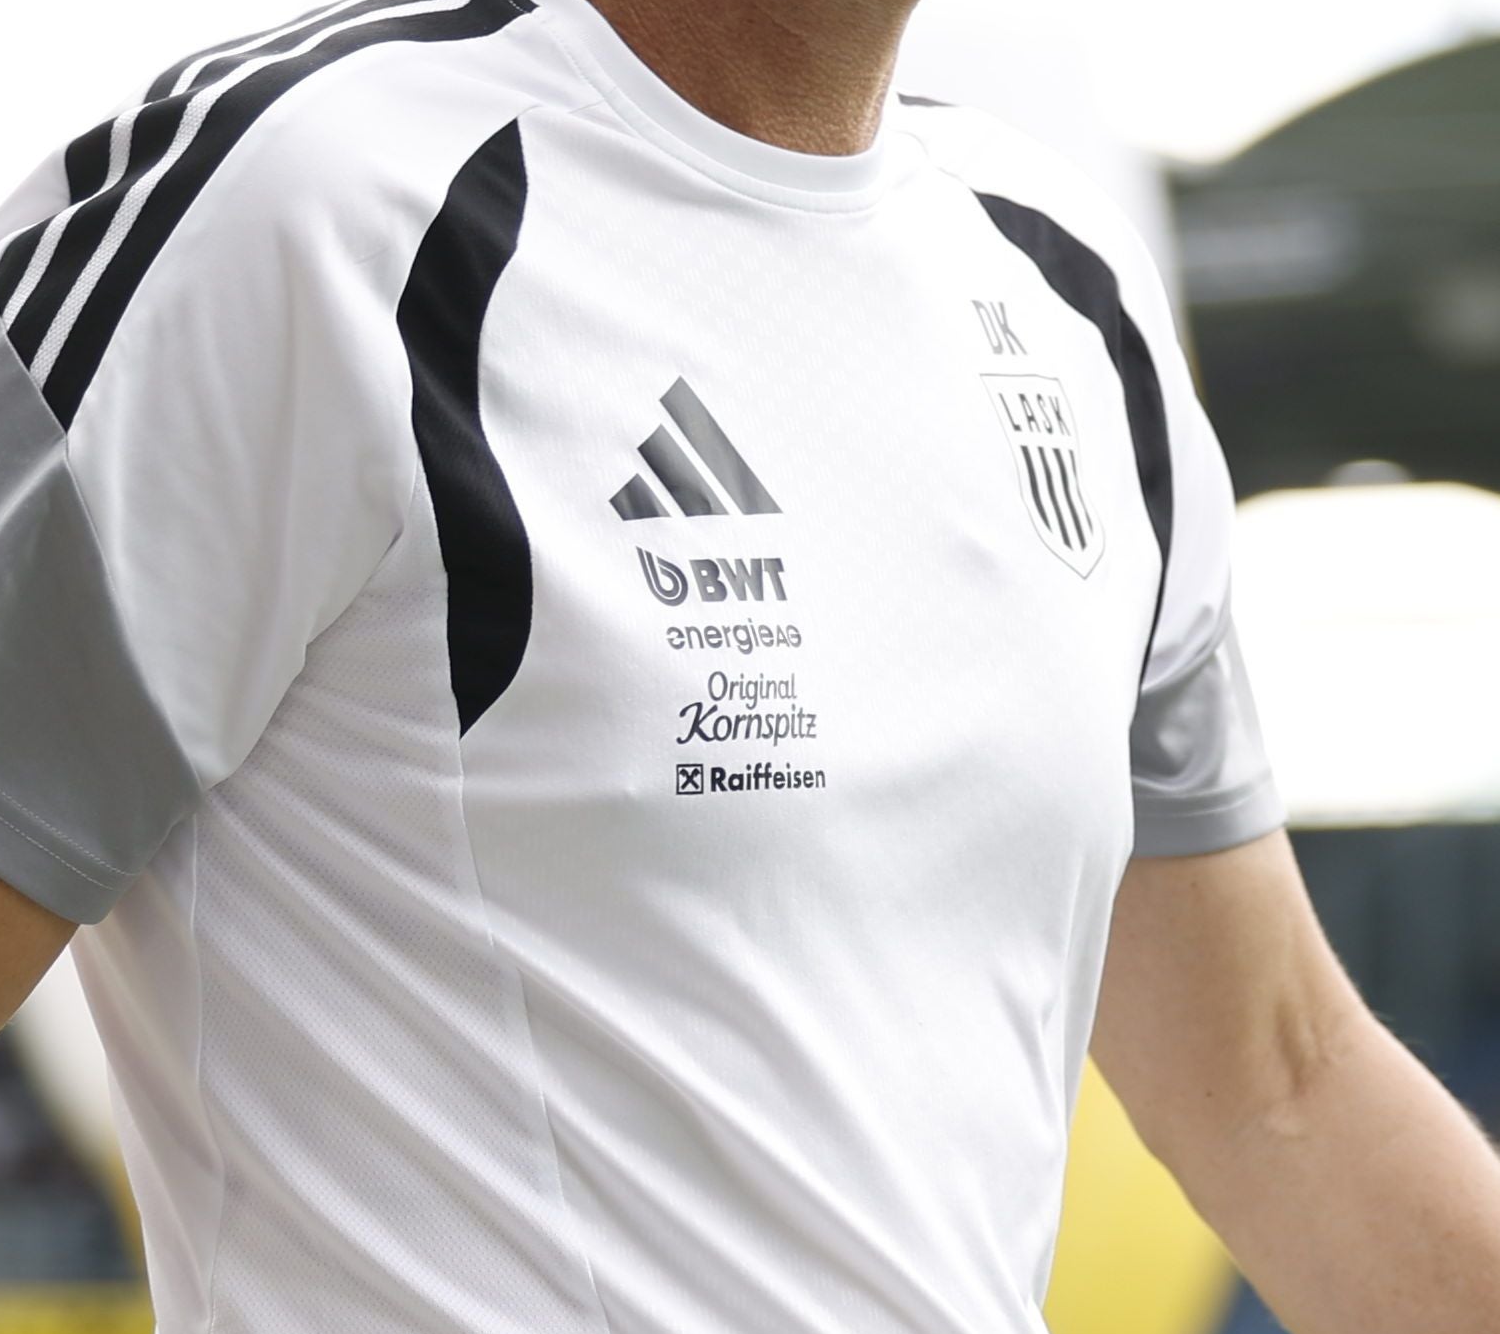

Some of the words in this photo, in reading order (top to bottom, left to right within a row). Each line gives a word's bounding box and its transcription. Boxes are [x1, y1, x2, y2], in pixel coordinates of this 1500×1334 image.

[971, 299, 1028, 355] DK
[998, 392, 1072, 437] LASK
[688, 557, 788, 603] BWT
[707, 670, 798, 710] Original
[676, 701, 818, 747] Kornspitz
[710, 762, 827, 793] Raiffeisen
